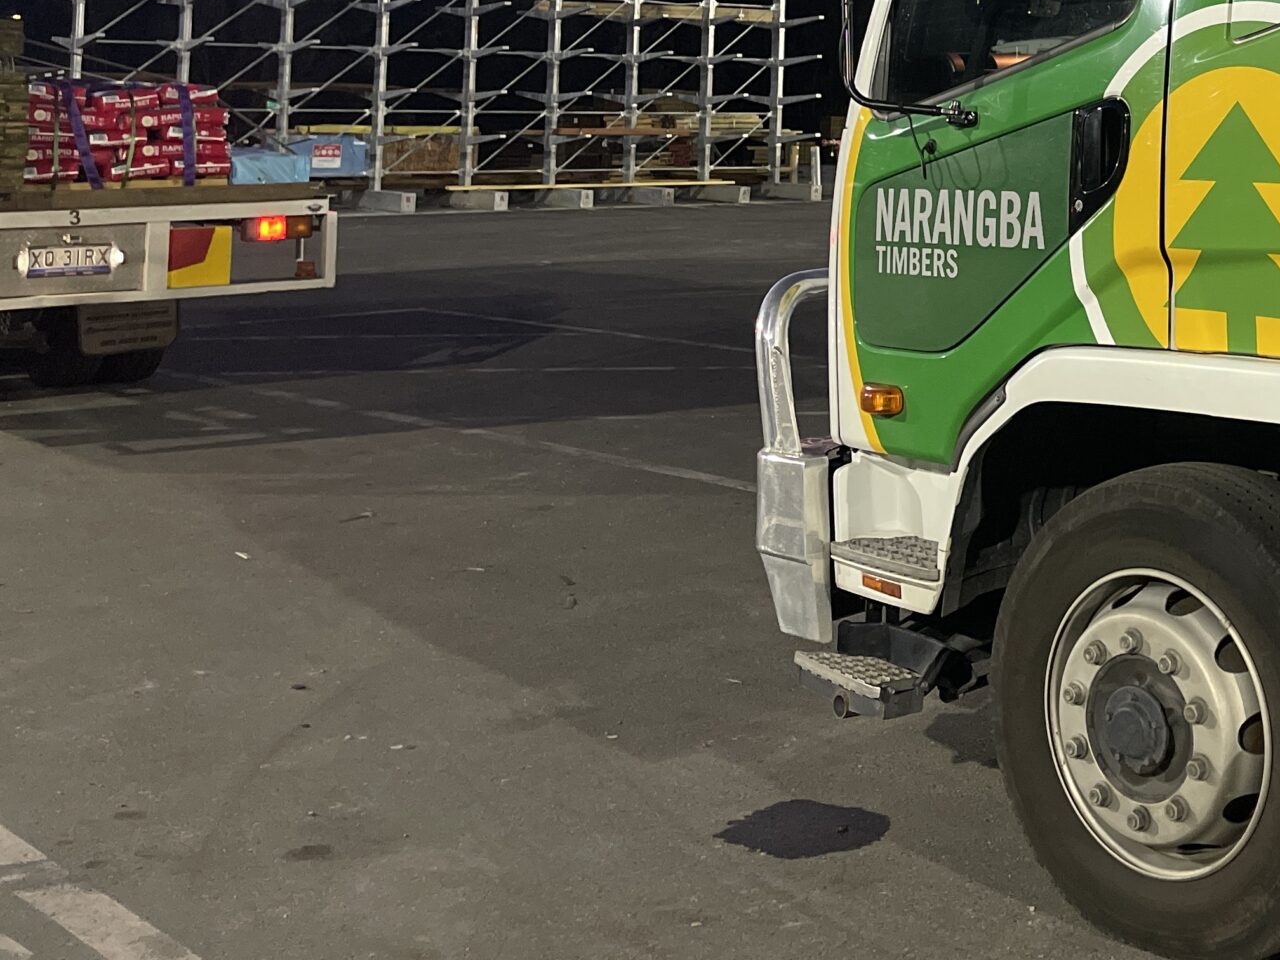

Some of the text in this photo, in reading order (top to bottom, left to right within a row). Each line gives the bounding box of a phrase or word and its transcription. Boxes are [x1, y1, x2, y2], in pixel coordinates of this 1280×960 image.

[69, 210, 81, 225] 3
[875, 188, 1046, 250] NARANGBA
[876, 245, 959, 279] TIMBERS
